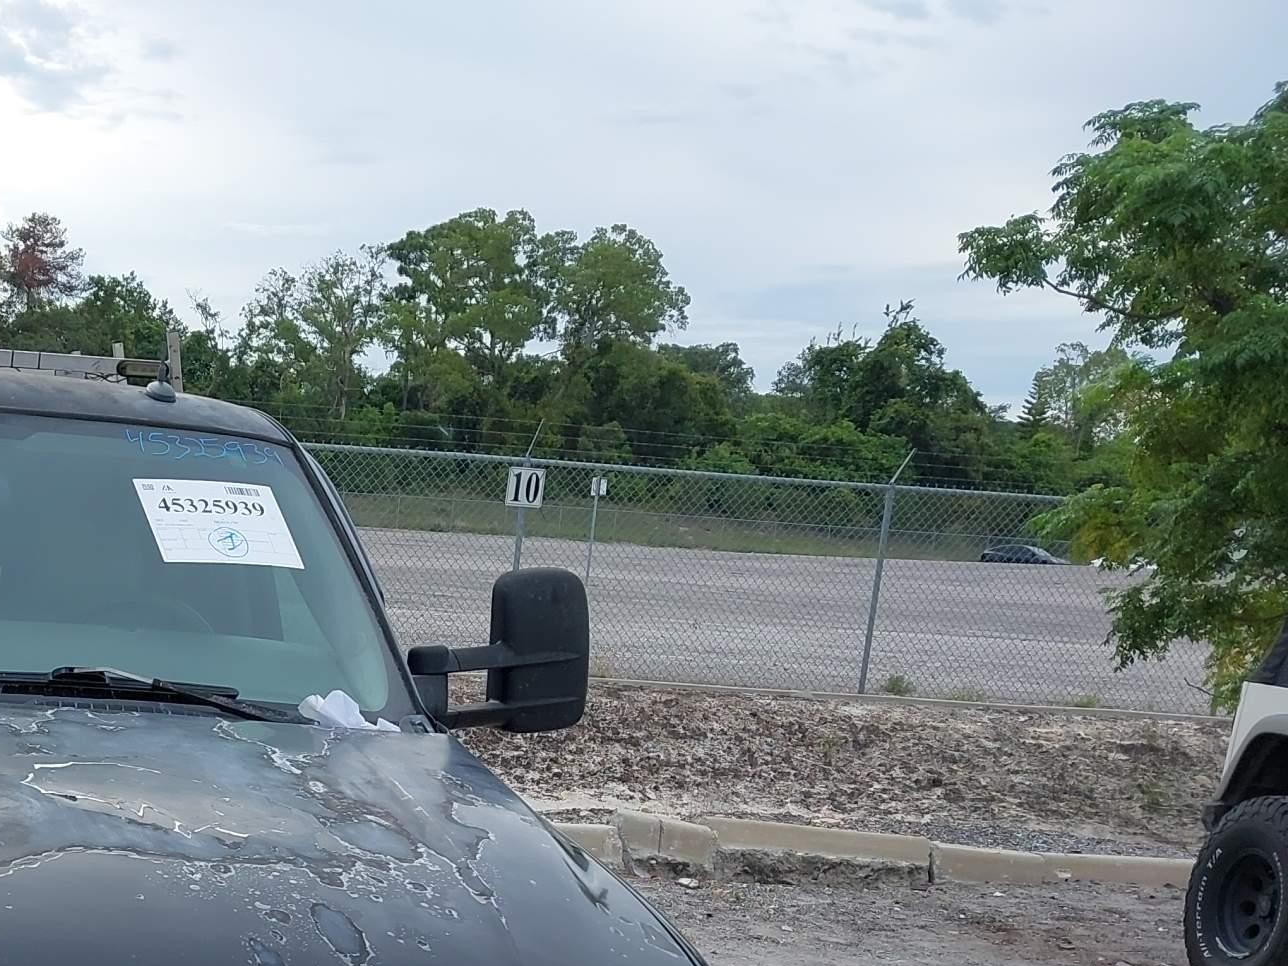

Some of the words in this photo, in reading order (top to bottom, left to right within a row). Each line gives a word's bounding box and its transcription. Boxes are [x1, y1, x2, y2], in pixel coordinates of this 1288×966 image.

[125, 428, 285, 466] 45325939
[512, 471, 541, 504] 10
[158, 497, 265, 517] 45325939
